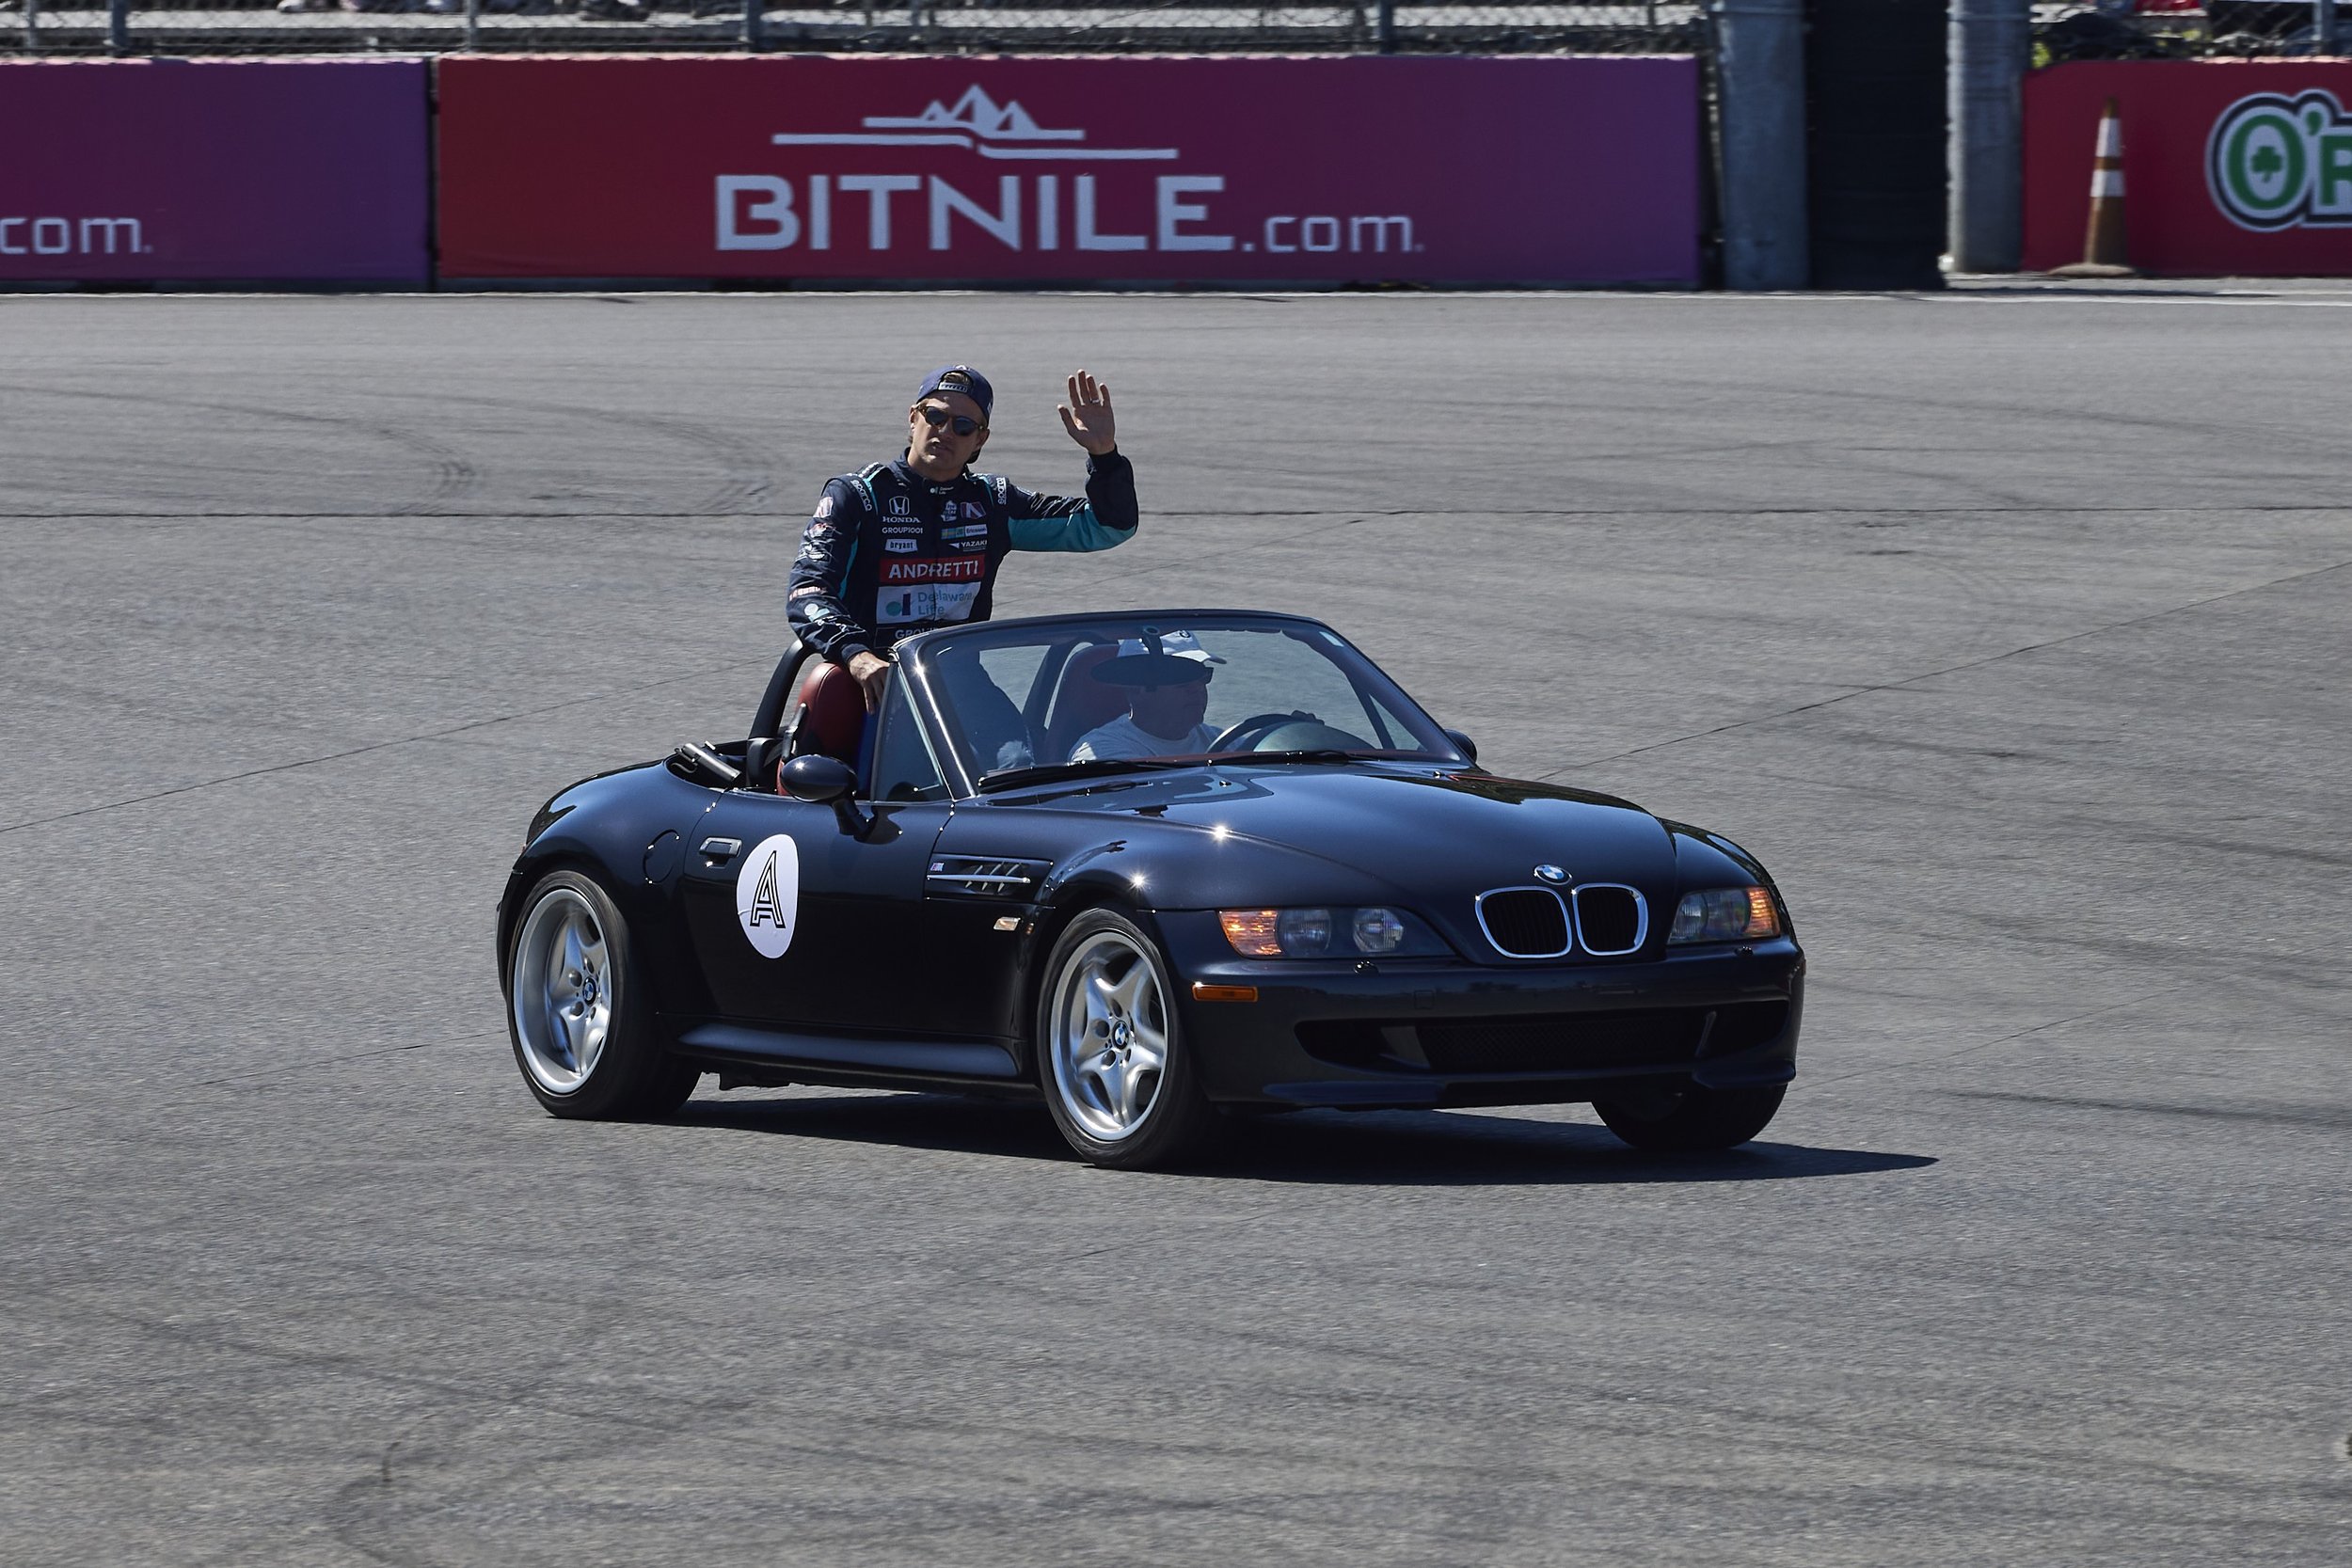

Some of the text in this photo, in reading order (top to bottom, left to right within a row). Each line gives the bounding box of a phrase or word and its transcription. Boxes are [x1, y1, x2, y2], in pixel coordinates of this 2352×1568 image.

[715, 174, 1413, 252] BITNILE.com
[889, 541, 914, 550] bryant
[961, 539, 987, 547] YAZAKI
[888, 560, 979, 578] ANDRETTI
[917, 590, 973, 603] Delaware
[917, 604, 946, 616] Life
[749, 849, 787, 929] A
